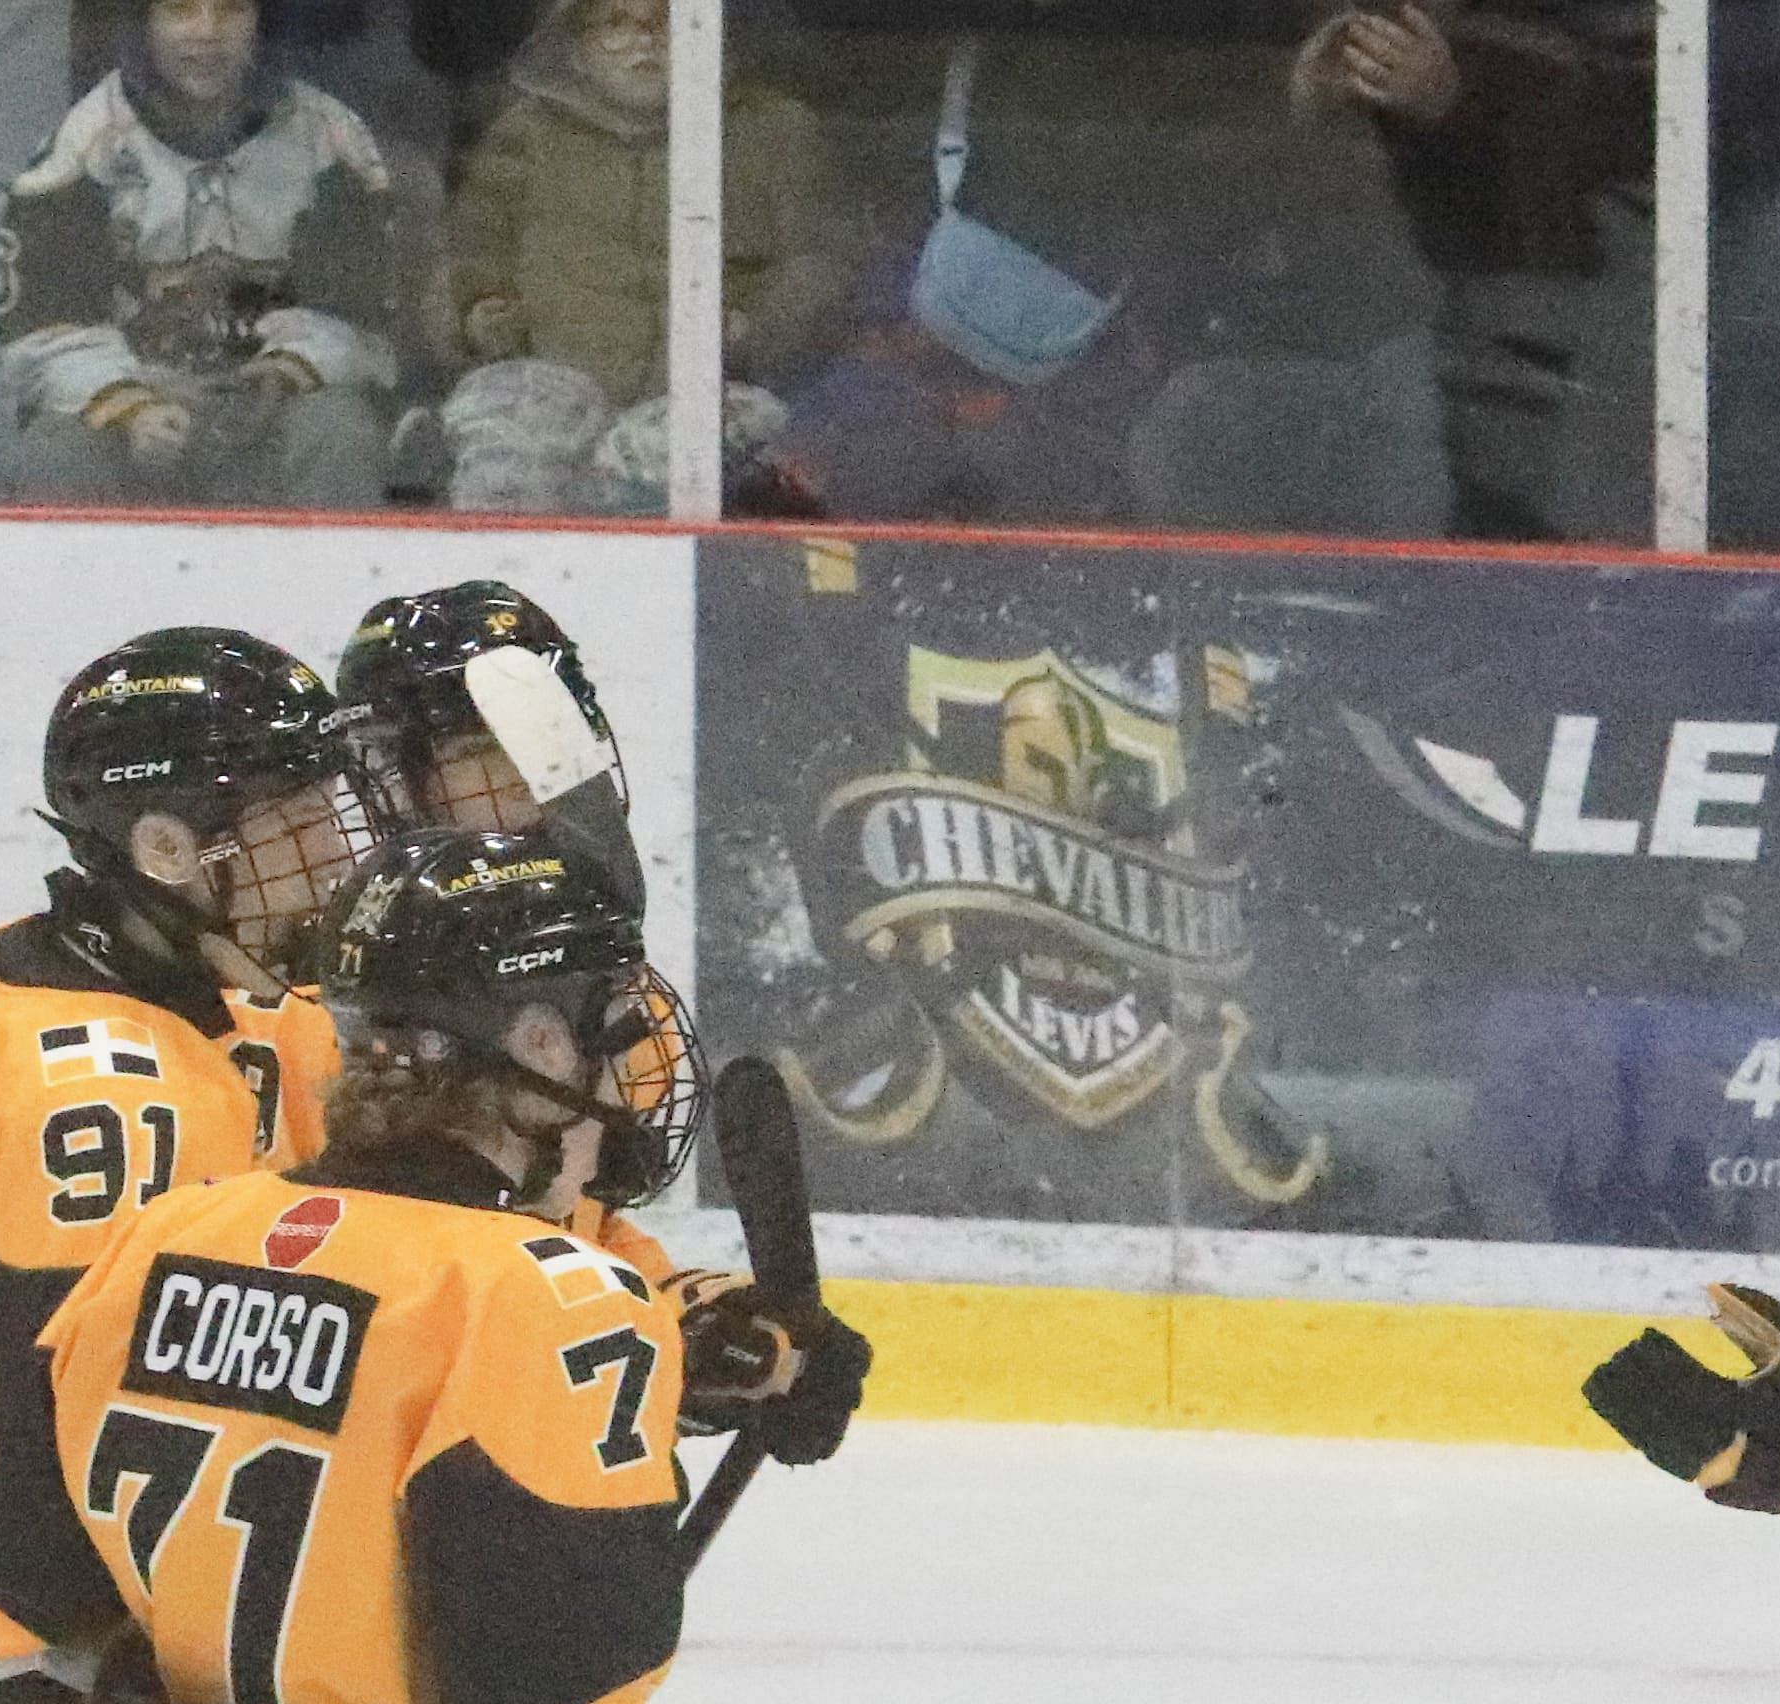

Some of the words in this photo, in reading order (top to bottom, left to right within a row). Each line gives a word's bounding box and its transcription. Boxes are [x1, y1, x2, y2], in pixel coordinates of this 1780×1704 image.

[72, 675, 206, 706] LAFONTAIN
[101, 760, 171, 783] CCM
[200, 840, 241, 865] CCM
[436, 857, 566, 900] LAFONTAINE
[497, 947, 565, 975] CCM
[42, 1101, 180, 1228] 91
[143, 1271, 349, 1407] CORSO
